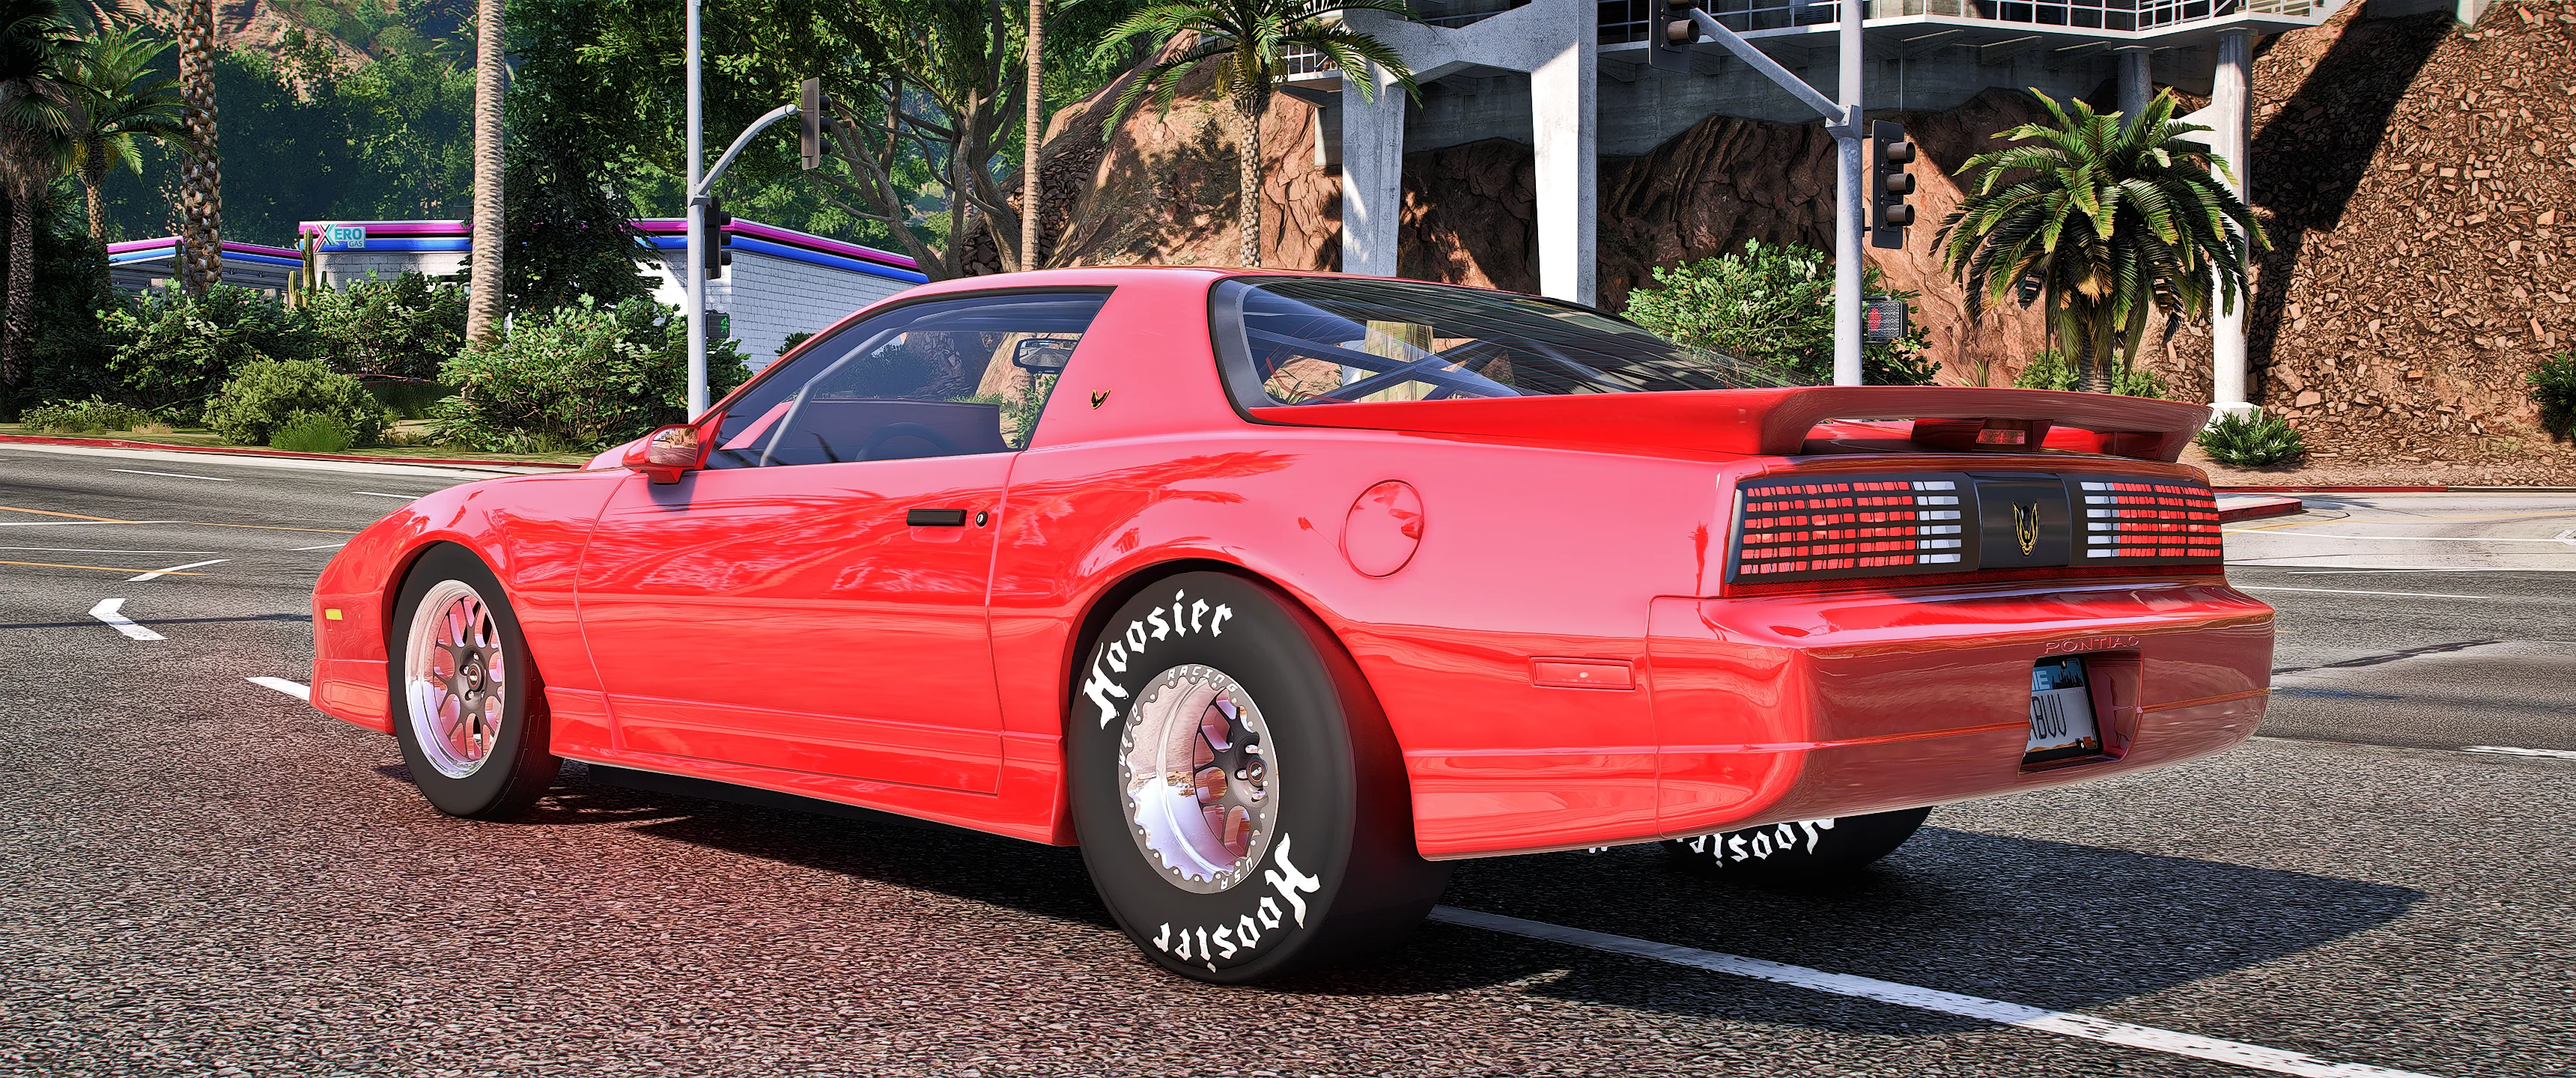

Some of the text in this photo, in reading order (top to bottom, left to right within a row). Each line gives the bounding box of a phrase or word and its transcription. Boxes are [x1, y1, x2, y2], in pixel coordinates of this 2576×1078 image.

[312, 224, 362, 252] XERO
[1082, 588, 1233, 730] Hoosier
[2044, 636, 2139, 654] PONTIAC
[1167, 666, 1239, 693] RACING
[1220, 856, 1254, 890] USA
[1152, 832, 1321, 973] Hoosier
